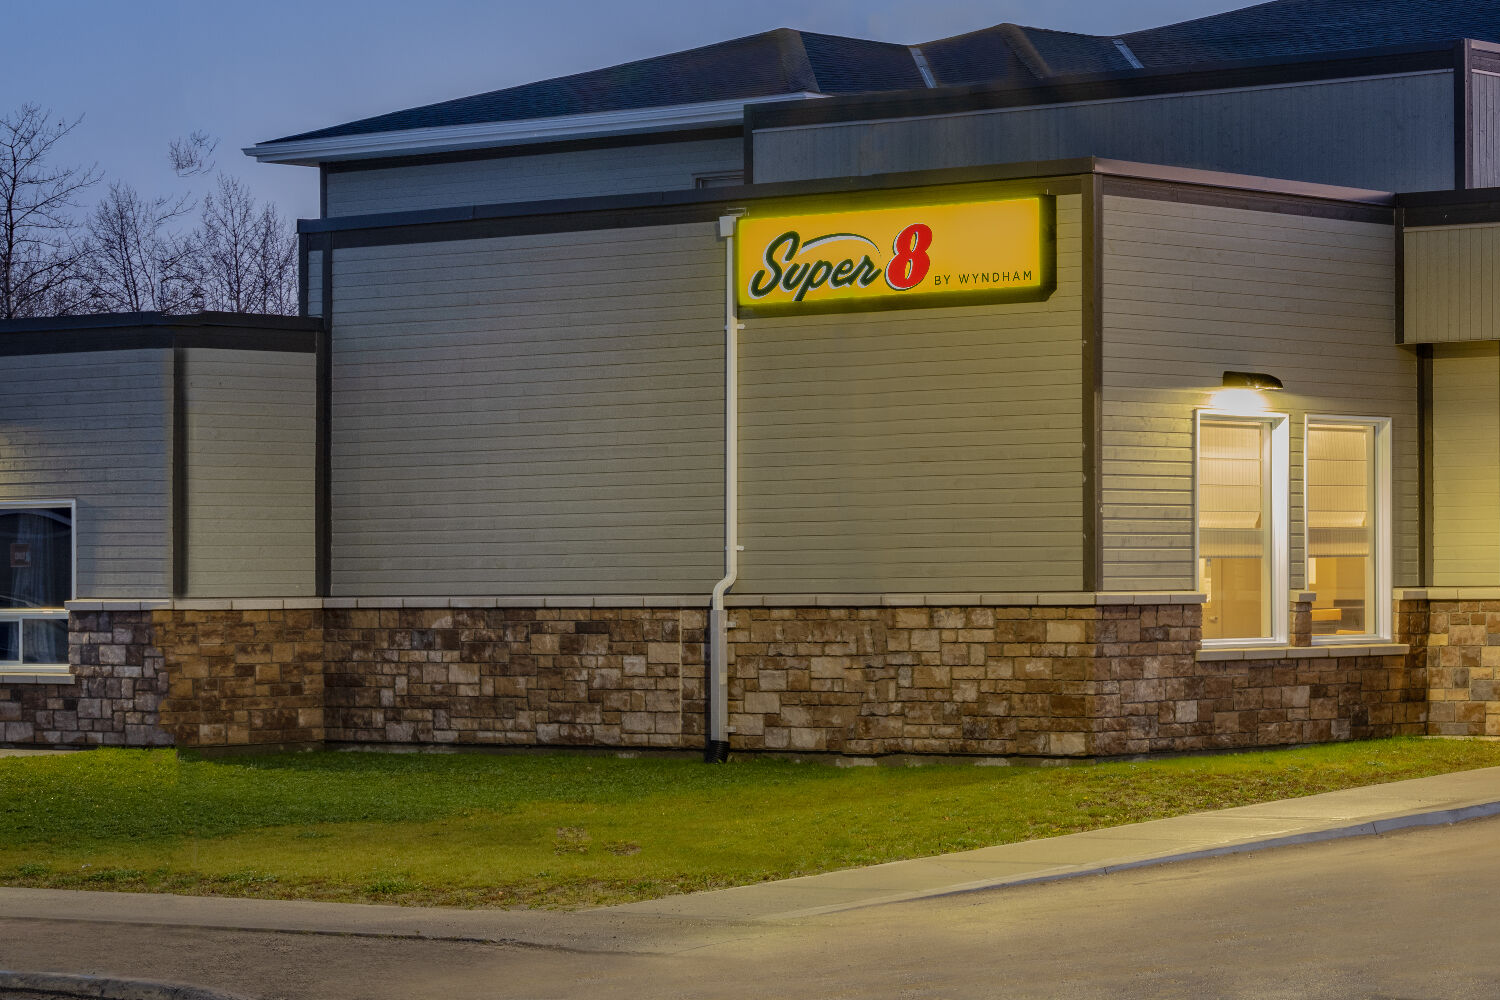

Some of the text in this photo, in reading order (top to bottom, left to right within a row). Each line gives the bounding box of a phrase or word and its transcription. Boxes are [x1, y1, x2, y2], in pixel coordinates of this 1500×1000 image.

[749, 223, 1031, 301] Super 8 BY WYNDHAM
